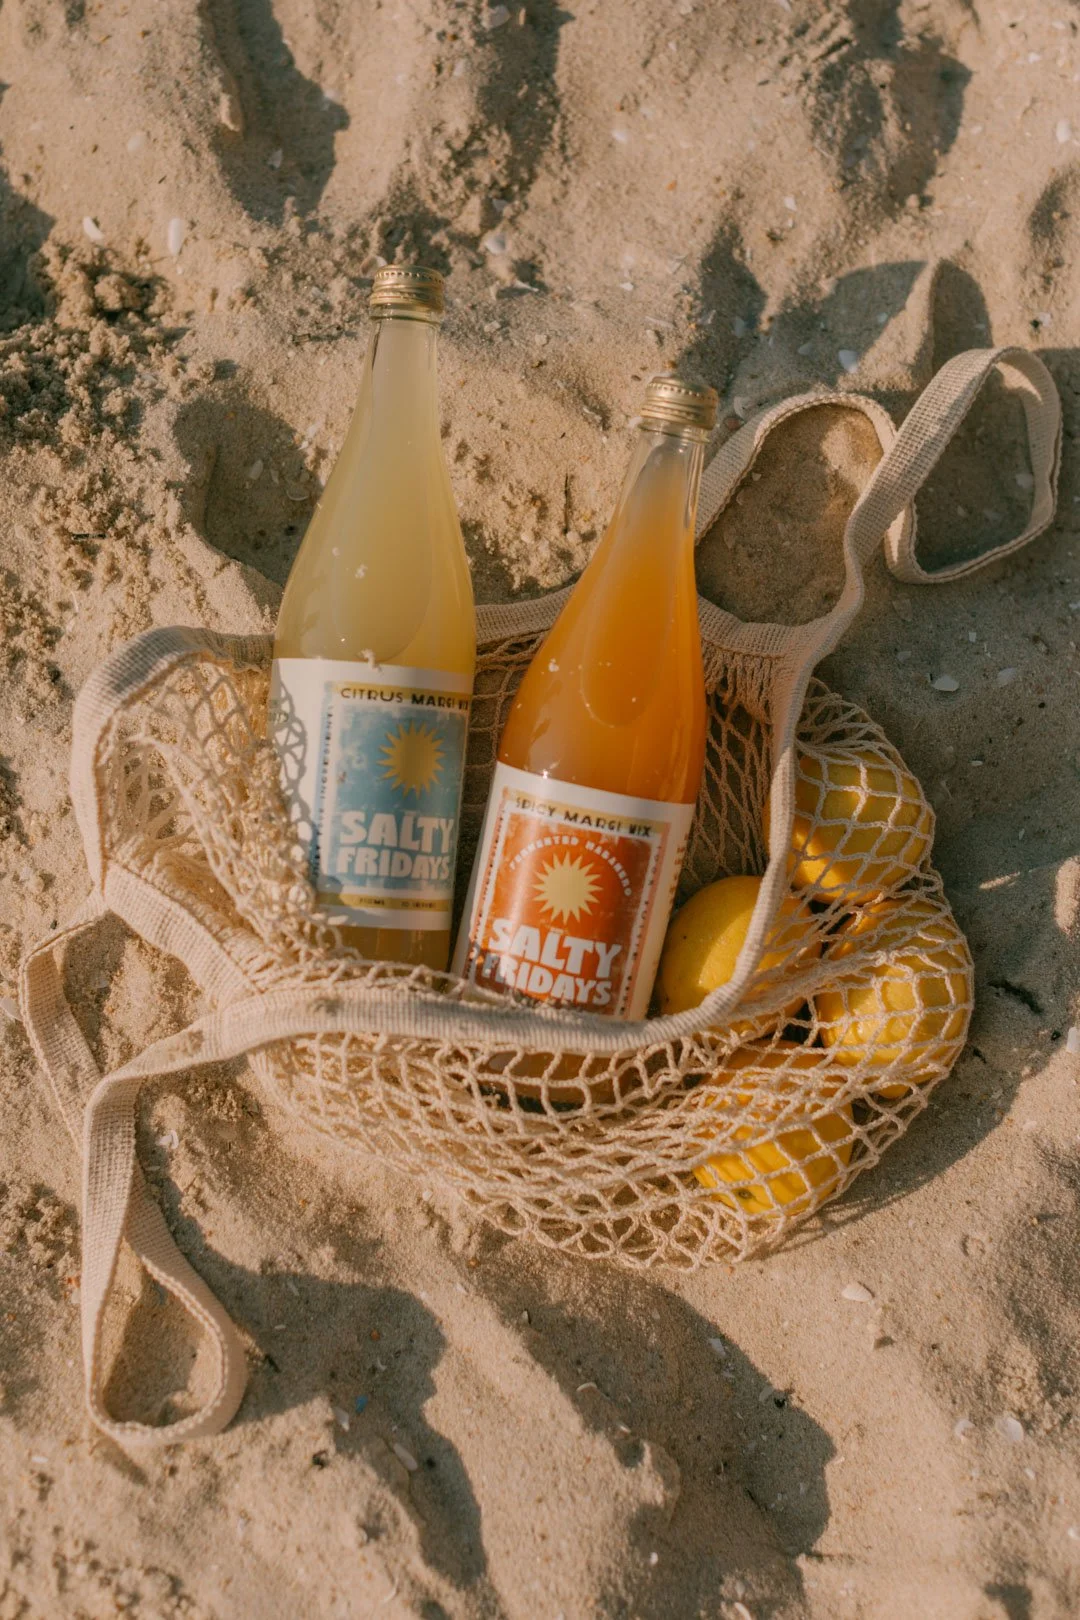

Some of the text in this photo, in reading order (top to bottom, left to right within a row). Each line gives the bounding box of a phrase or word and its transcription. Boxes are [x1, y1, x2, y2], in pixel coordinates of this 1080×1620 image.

[341, 687, 403, 703] CITRUS
[338, 809, 455, 855] SALTY
[515, 797, 556, 817] SPICY
[563, 809, 622, 832] MARGI
[335, 845, 451, 880] FRIDAYS
[488, 917, 623, 979] SALTY
[482, 952, 613, 1006] FRIDAYS
